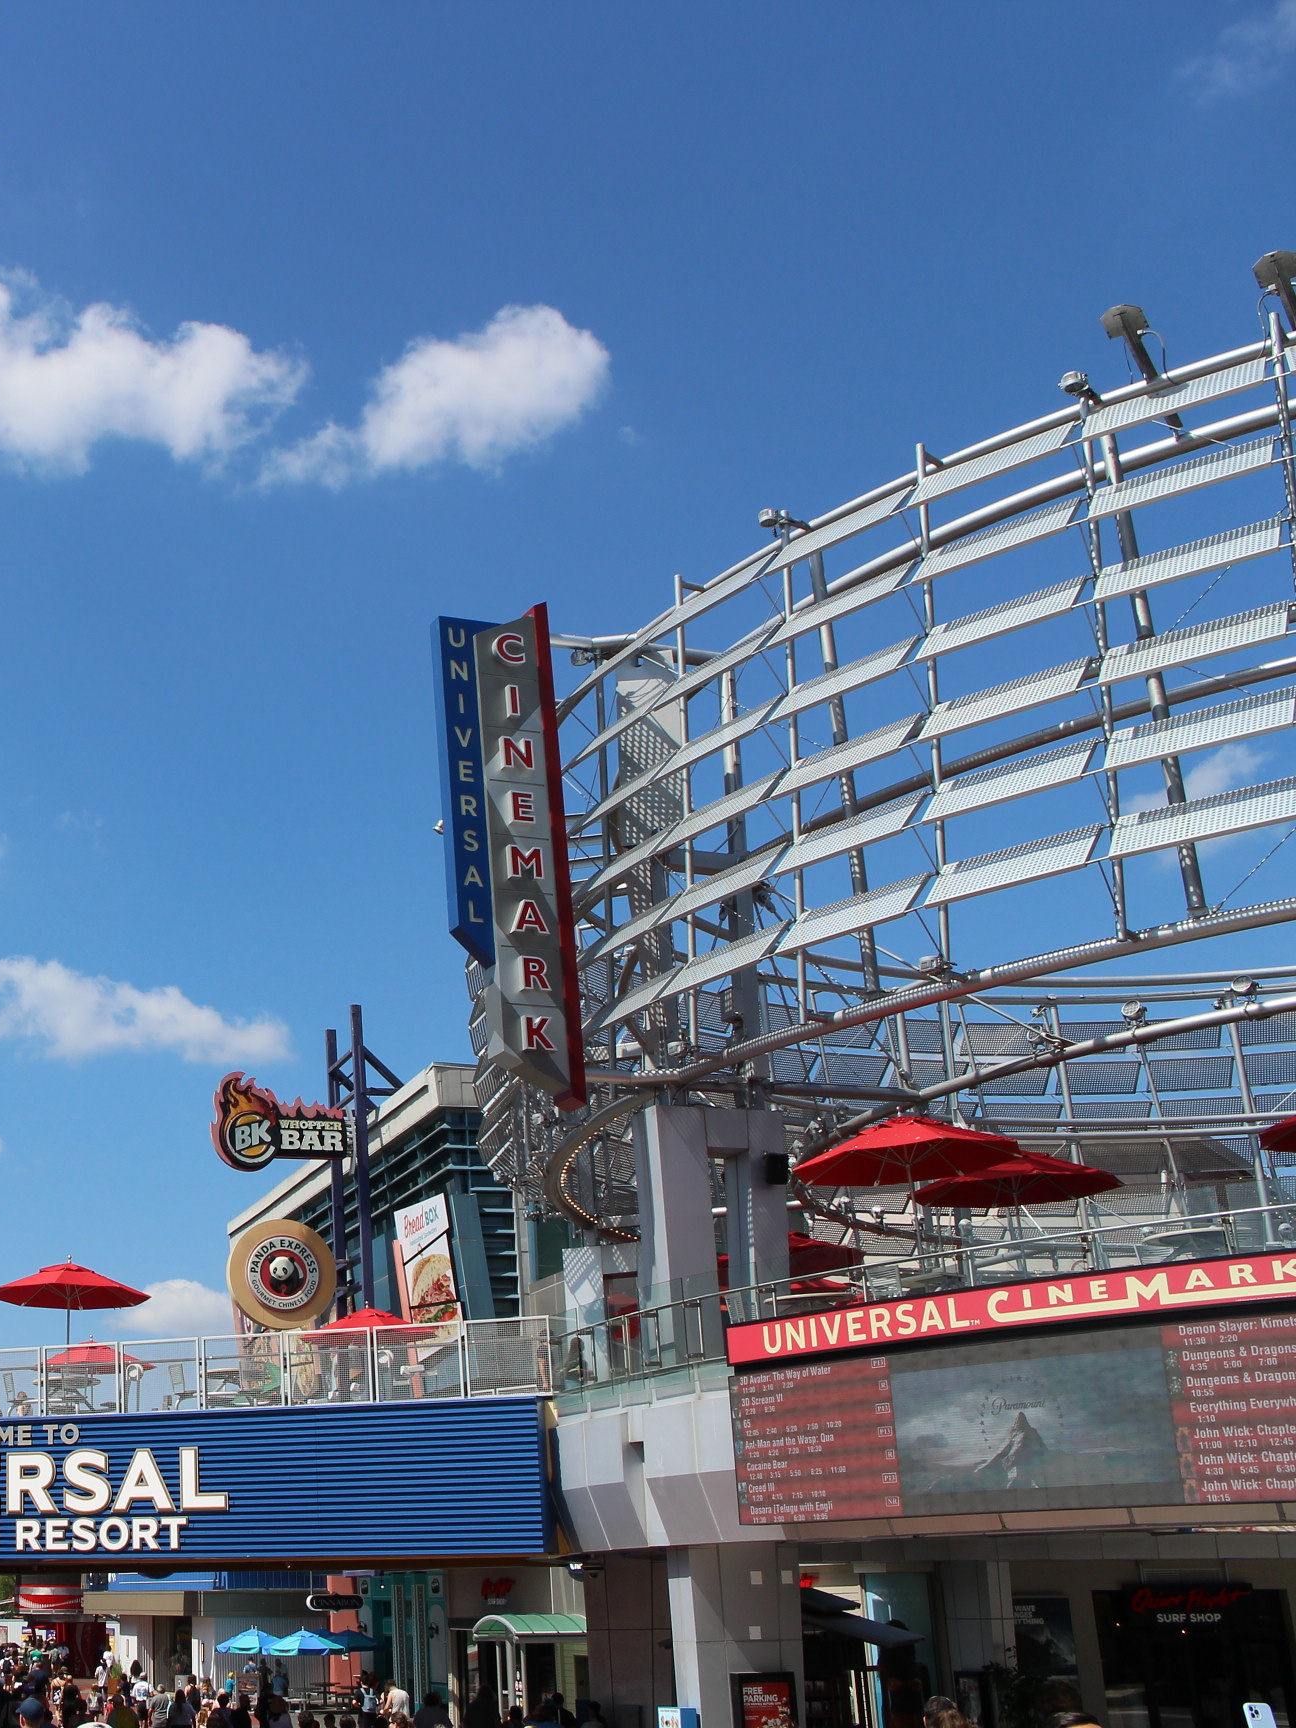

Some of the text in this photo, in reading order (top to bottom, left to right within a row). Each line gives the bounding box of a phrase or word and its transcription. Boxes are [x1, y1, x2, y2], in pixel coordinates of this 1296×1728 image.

[447, 626, 484, 924] UNIVERSAL
[492, 634, 557, 1052] CINEMARK
[279, 1119, 342, 1130] WHOPPER
[234, 1120, 271, 1151] BK
[280, 1129, 343, 1151] BAR
[404, 1205, 424, 1238] Bread
[424, 1205, 439, 1226] BOX
[250, 1239, 317, 1273] PANDA EXPRESS
[251, 1279, 316, 1307] GOURMET CHINESE FOOD
[987, 1257, 1296, 1322] CINEMARK
[763, 1298, 970, 1354] UNIVERSAL
[1179, 1324, 1215, 1336] Demon
[1219, 1321, 1257, 1333] Slayer:
[1184, 1337, 1206, 1346] 11:30
[1183, 1344, 1296, 1362] Dungeons & Dragons
[1190, 1363, 1207, 1371] 4:35
[1224, 1360, 1241, 1369] 5:00
[740, 1366, 830, 1385] 3D Avatar: The Way of Water
[1187, 1371, 1296, 1388] Dungeons & Dragon
[742, 1394, 783, 1406] 3D Scream VI
[991, 1397, 1046, 1415] Paramount
[1190, 1396, 1296, 1413] Everything Everywh
[744, 1420, 751, 1428] 65
[1198, 1415, 1215, 1423] 1:10
[42, 1423, 80, 1446] TO
[1194, 1424, 1296, 1439] John Wick: Chapte
[745, 1433, 834, 1450] Ant-Man and the Wasp: Qua
[1199, 1437, 1293, 1449] 11:00 12:10 12:45
[747, 1460, 787, 1470] Cocaine Bear
[1198, 1455, 1223, 1466] John
[1227, 1453, 1257, 1464] Wick:
[1240, 1466, 1259, 1474] 5:45
[1277, 1465, 1296, 1473] 6:30
[749, 1484, 766, 1493] Creed
[1202, 1481, 1227, 1492] John
[1230, 1479, 1261, 1489] Wick:
[1207, 1494, 1230, 1502] 10:15
[751, 1506, 771, 1515] Dasara
[816, 1501, 832, 1511] Engli
[15, 1516, 188, 1552] RESORT
[1157, 1613, 1221, 1623] SURF SHOP
[743, 1694, 778, 1702] PARKING
